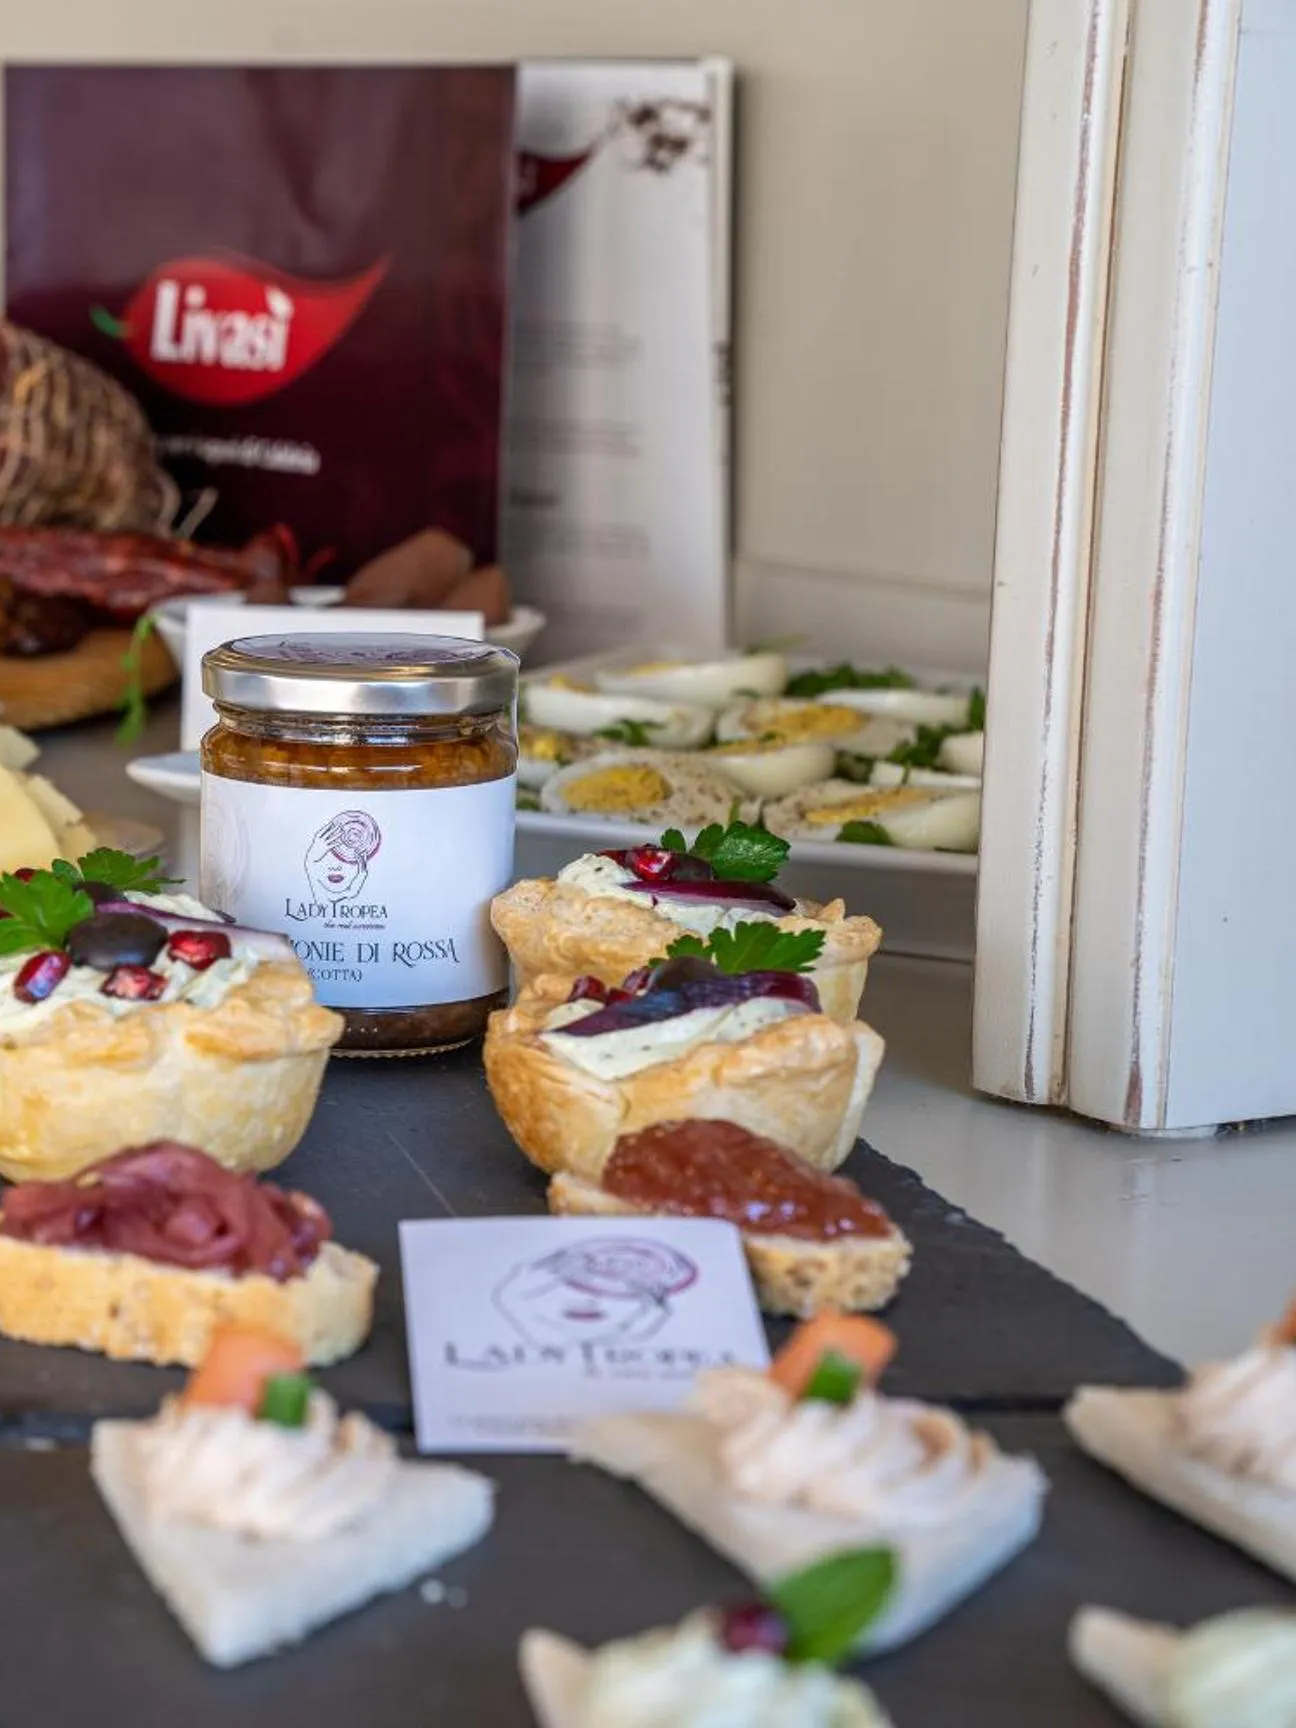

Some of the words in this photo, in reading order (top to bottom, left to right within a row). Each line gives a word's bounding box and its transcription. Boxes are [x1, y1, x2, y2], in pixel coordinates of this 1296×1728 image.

[289, 938, 345, 963] ONIE
[357, 941, 380, 964] DI
[392, 937, 461, 968] ROSSA
